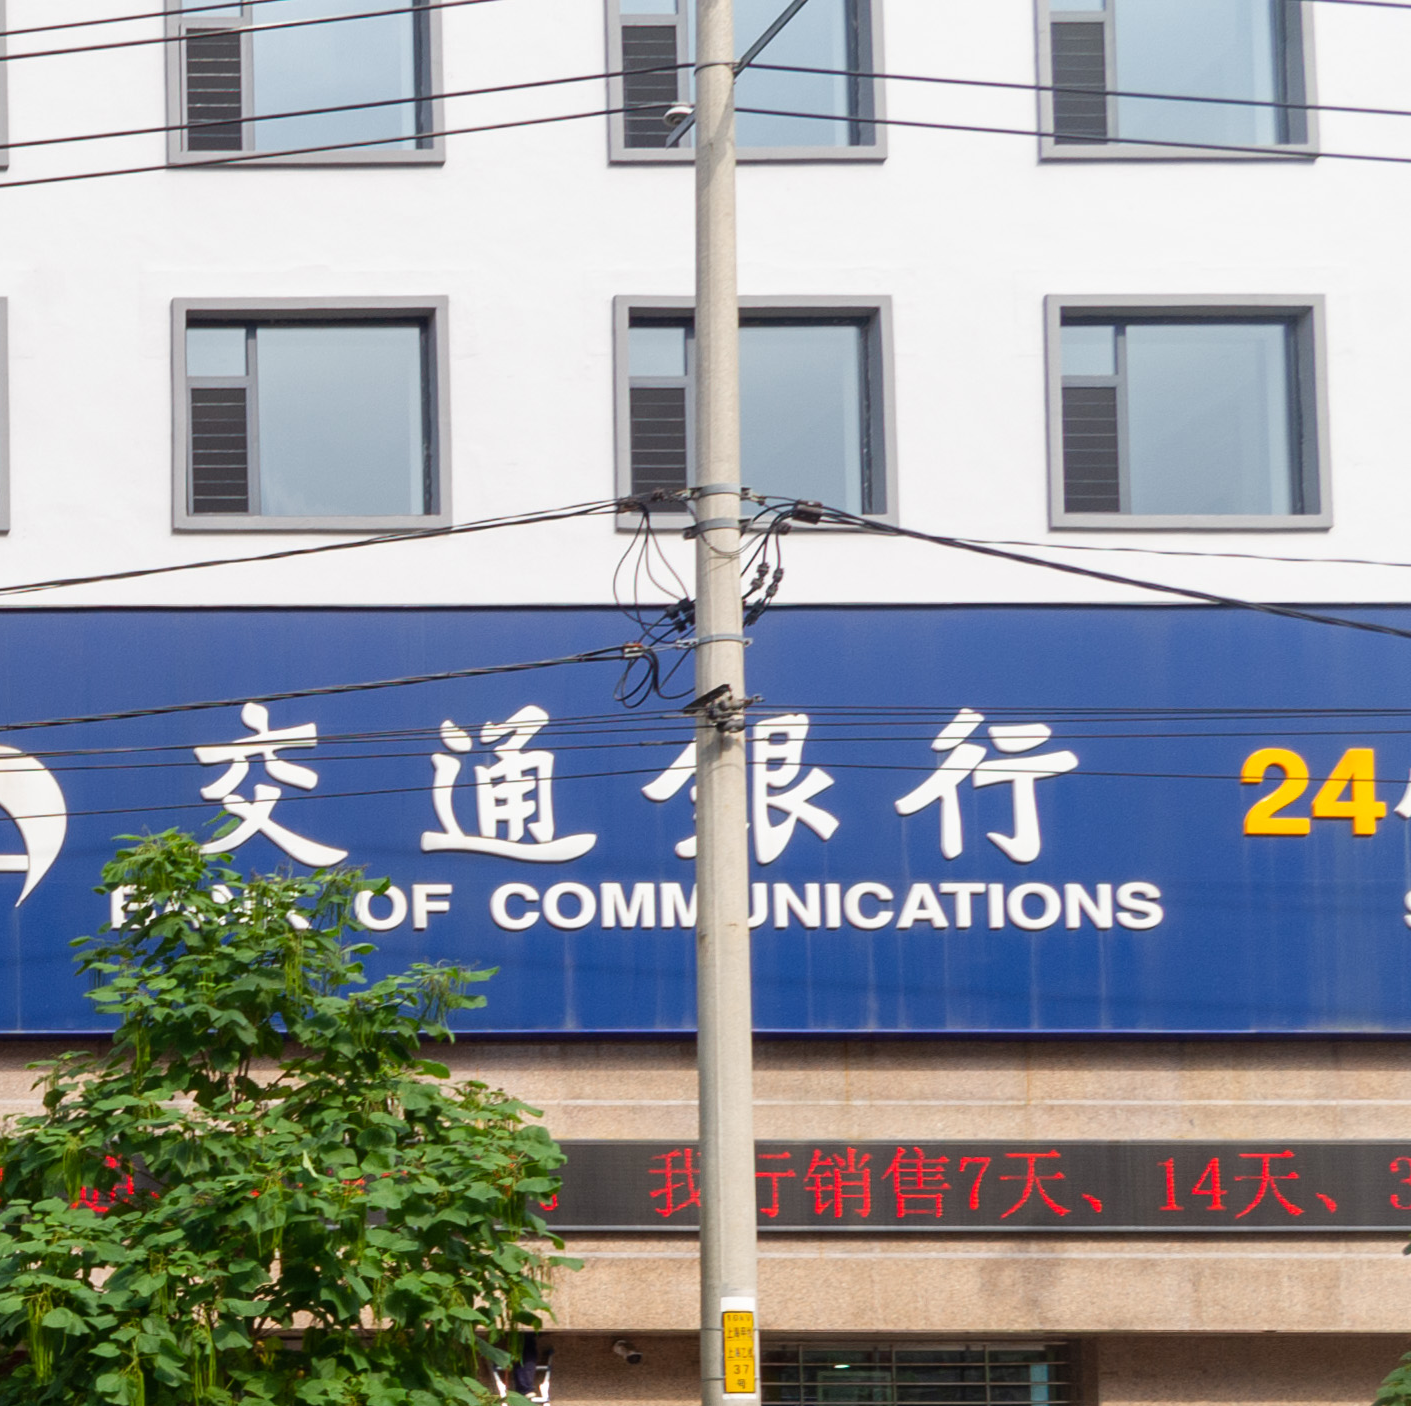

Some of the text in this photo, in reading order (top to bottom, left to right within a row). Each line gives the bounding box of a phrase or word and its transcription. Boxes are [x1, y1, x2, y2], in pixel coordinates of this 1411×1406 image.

[194, 702, 1079, 864] 交通银行
[1240, 747, 1411, 837] 24
[354, 884, 453, 931] OF
